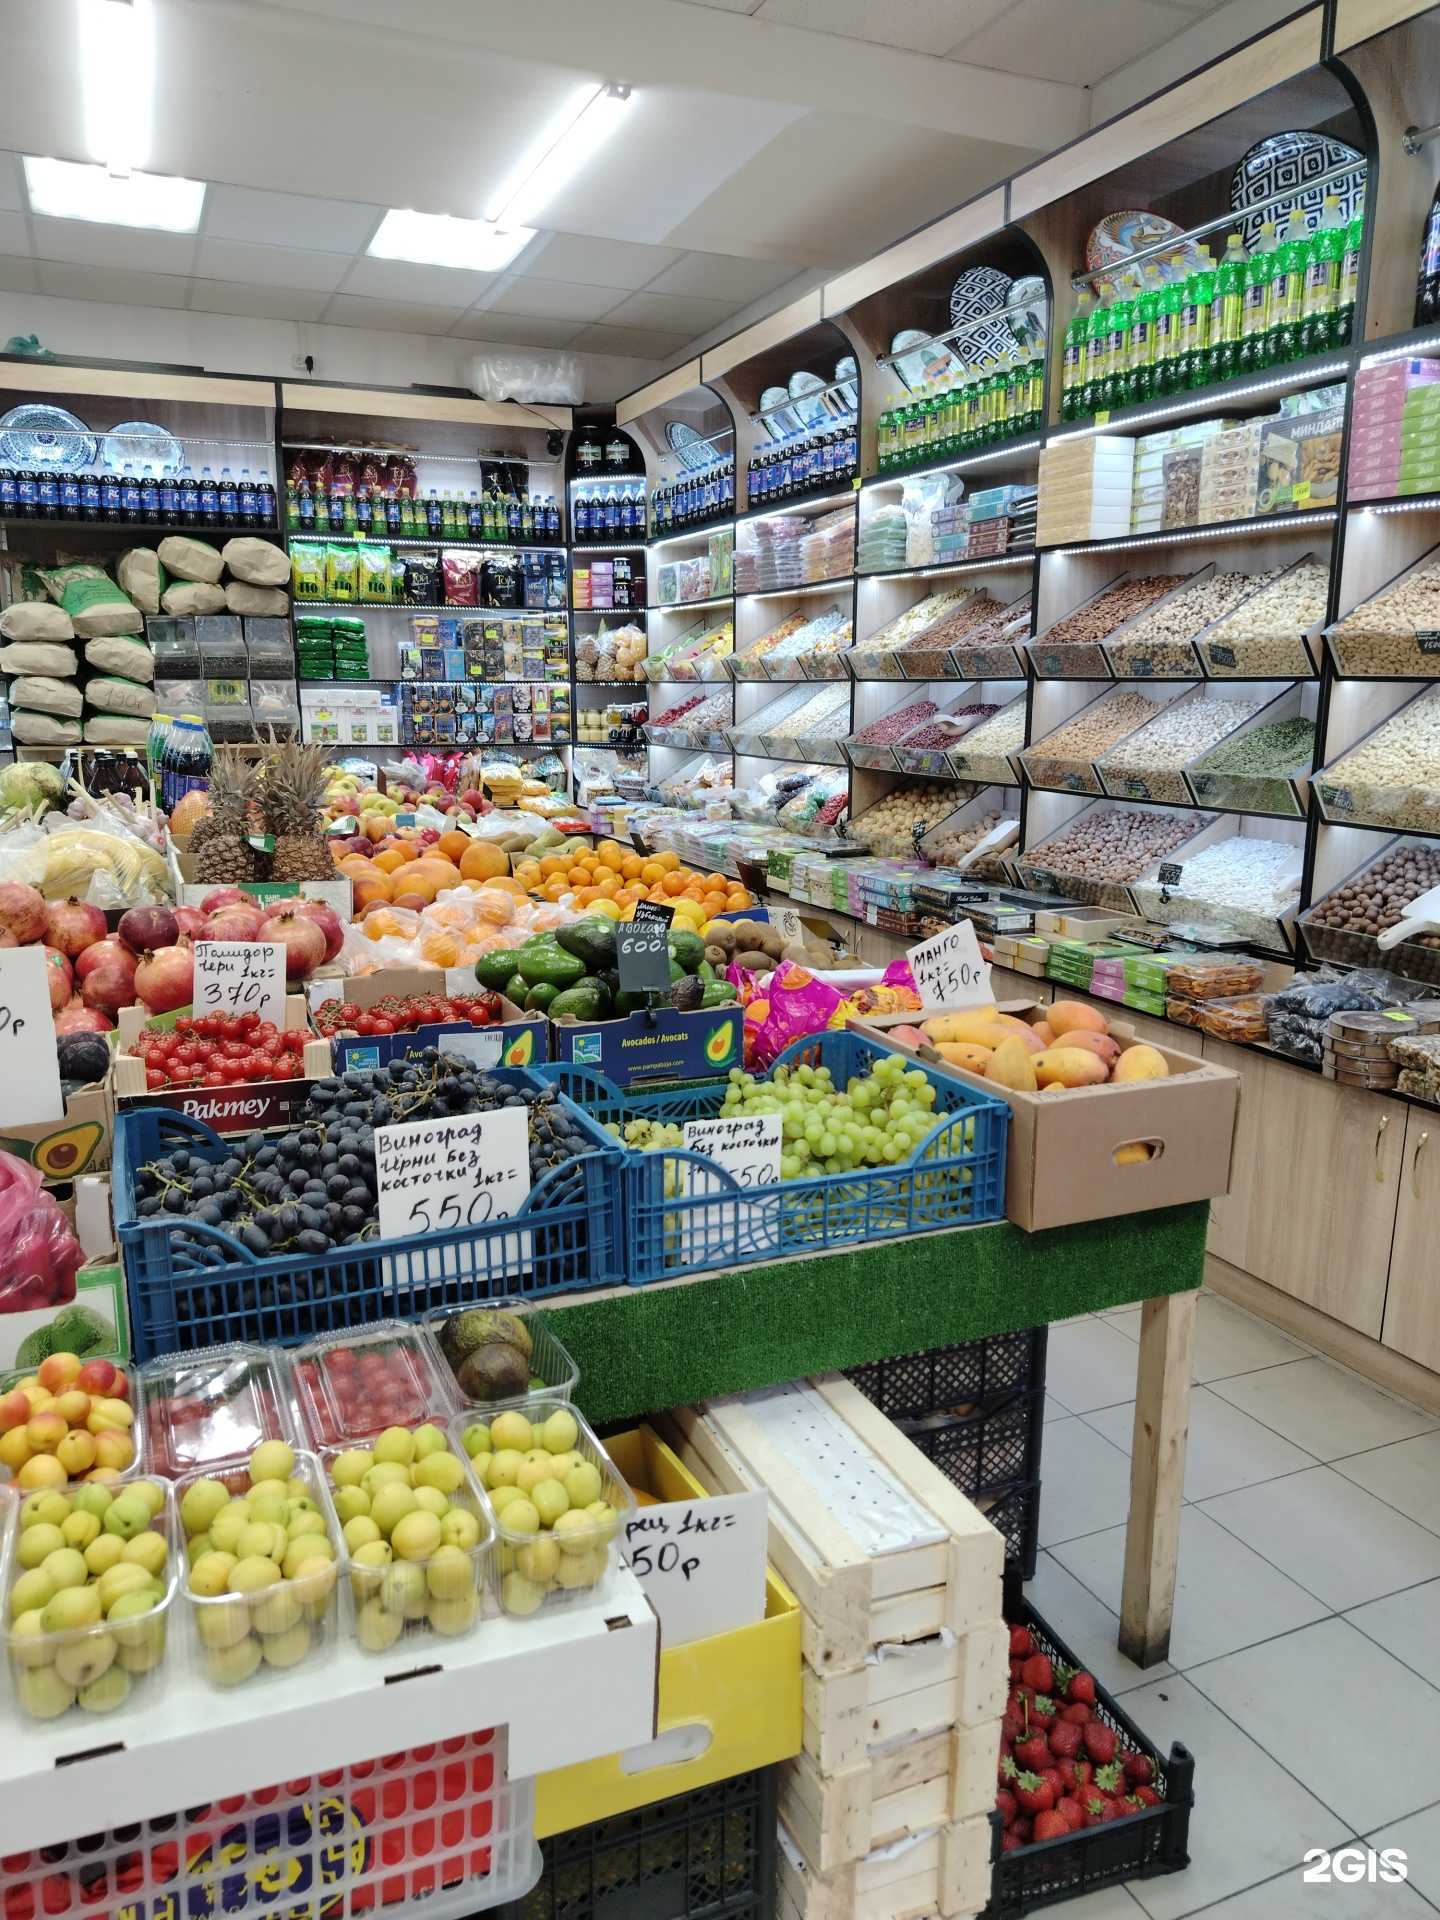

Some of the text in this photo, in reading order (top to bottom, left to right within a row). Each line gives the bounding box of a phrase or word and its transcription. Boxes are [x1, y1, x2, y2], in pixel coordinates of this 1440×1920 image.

[621, 1035, 656, 1048] Avocados
[661, 1031, 689, 1043] Avocats
[182, 1096, 271, 1119] Pakmey
[378, 1122, 482, 1154] Виноград
[688, 1119, 766, 1138] Виноград
